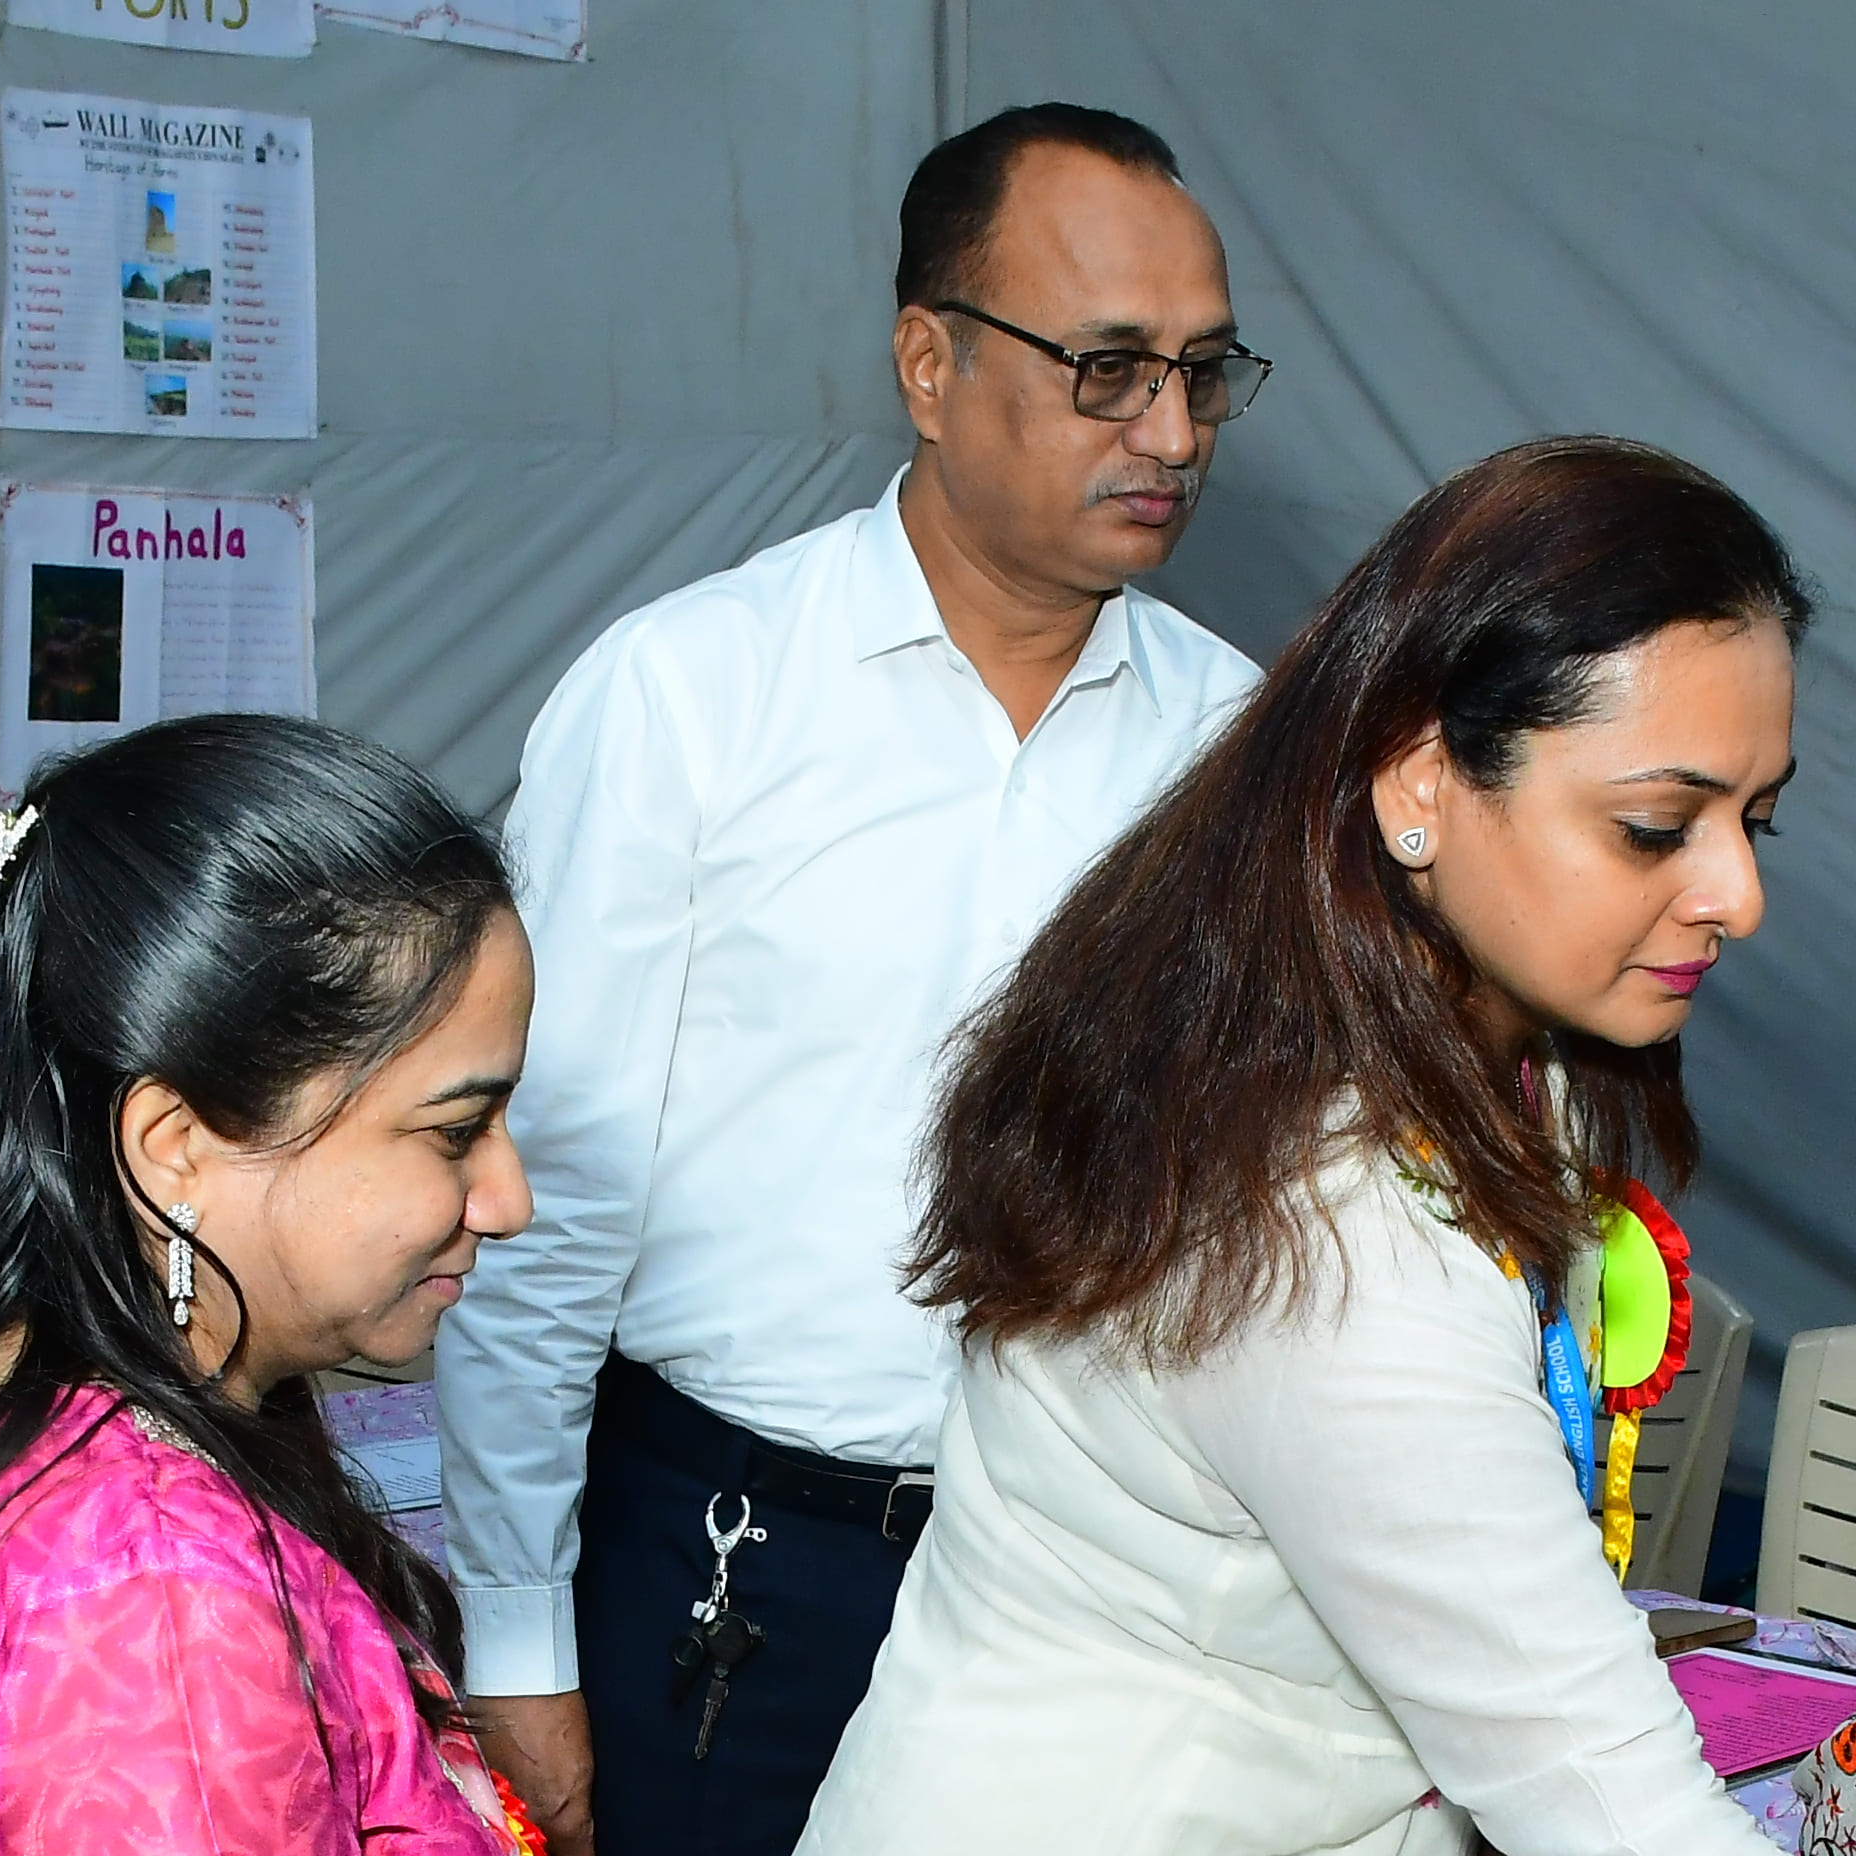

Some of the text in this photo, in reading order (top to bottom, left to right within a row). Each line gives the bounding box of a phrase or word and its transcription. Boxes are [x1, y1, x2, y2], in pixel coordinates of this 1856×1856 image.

[76, 109, 244, 150] WALL MAGAZINE
[93, 499, 246, 561] Panhala
[1546, 1334, 1575, 1394] SCHOOL
[1562, 1397, 1585, 1460] ENGLISH
